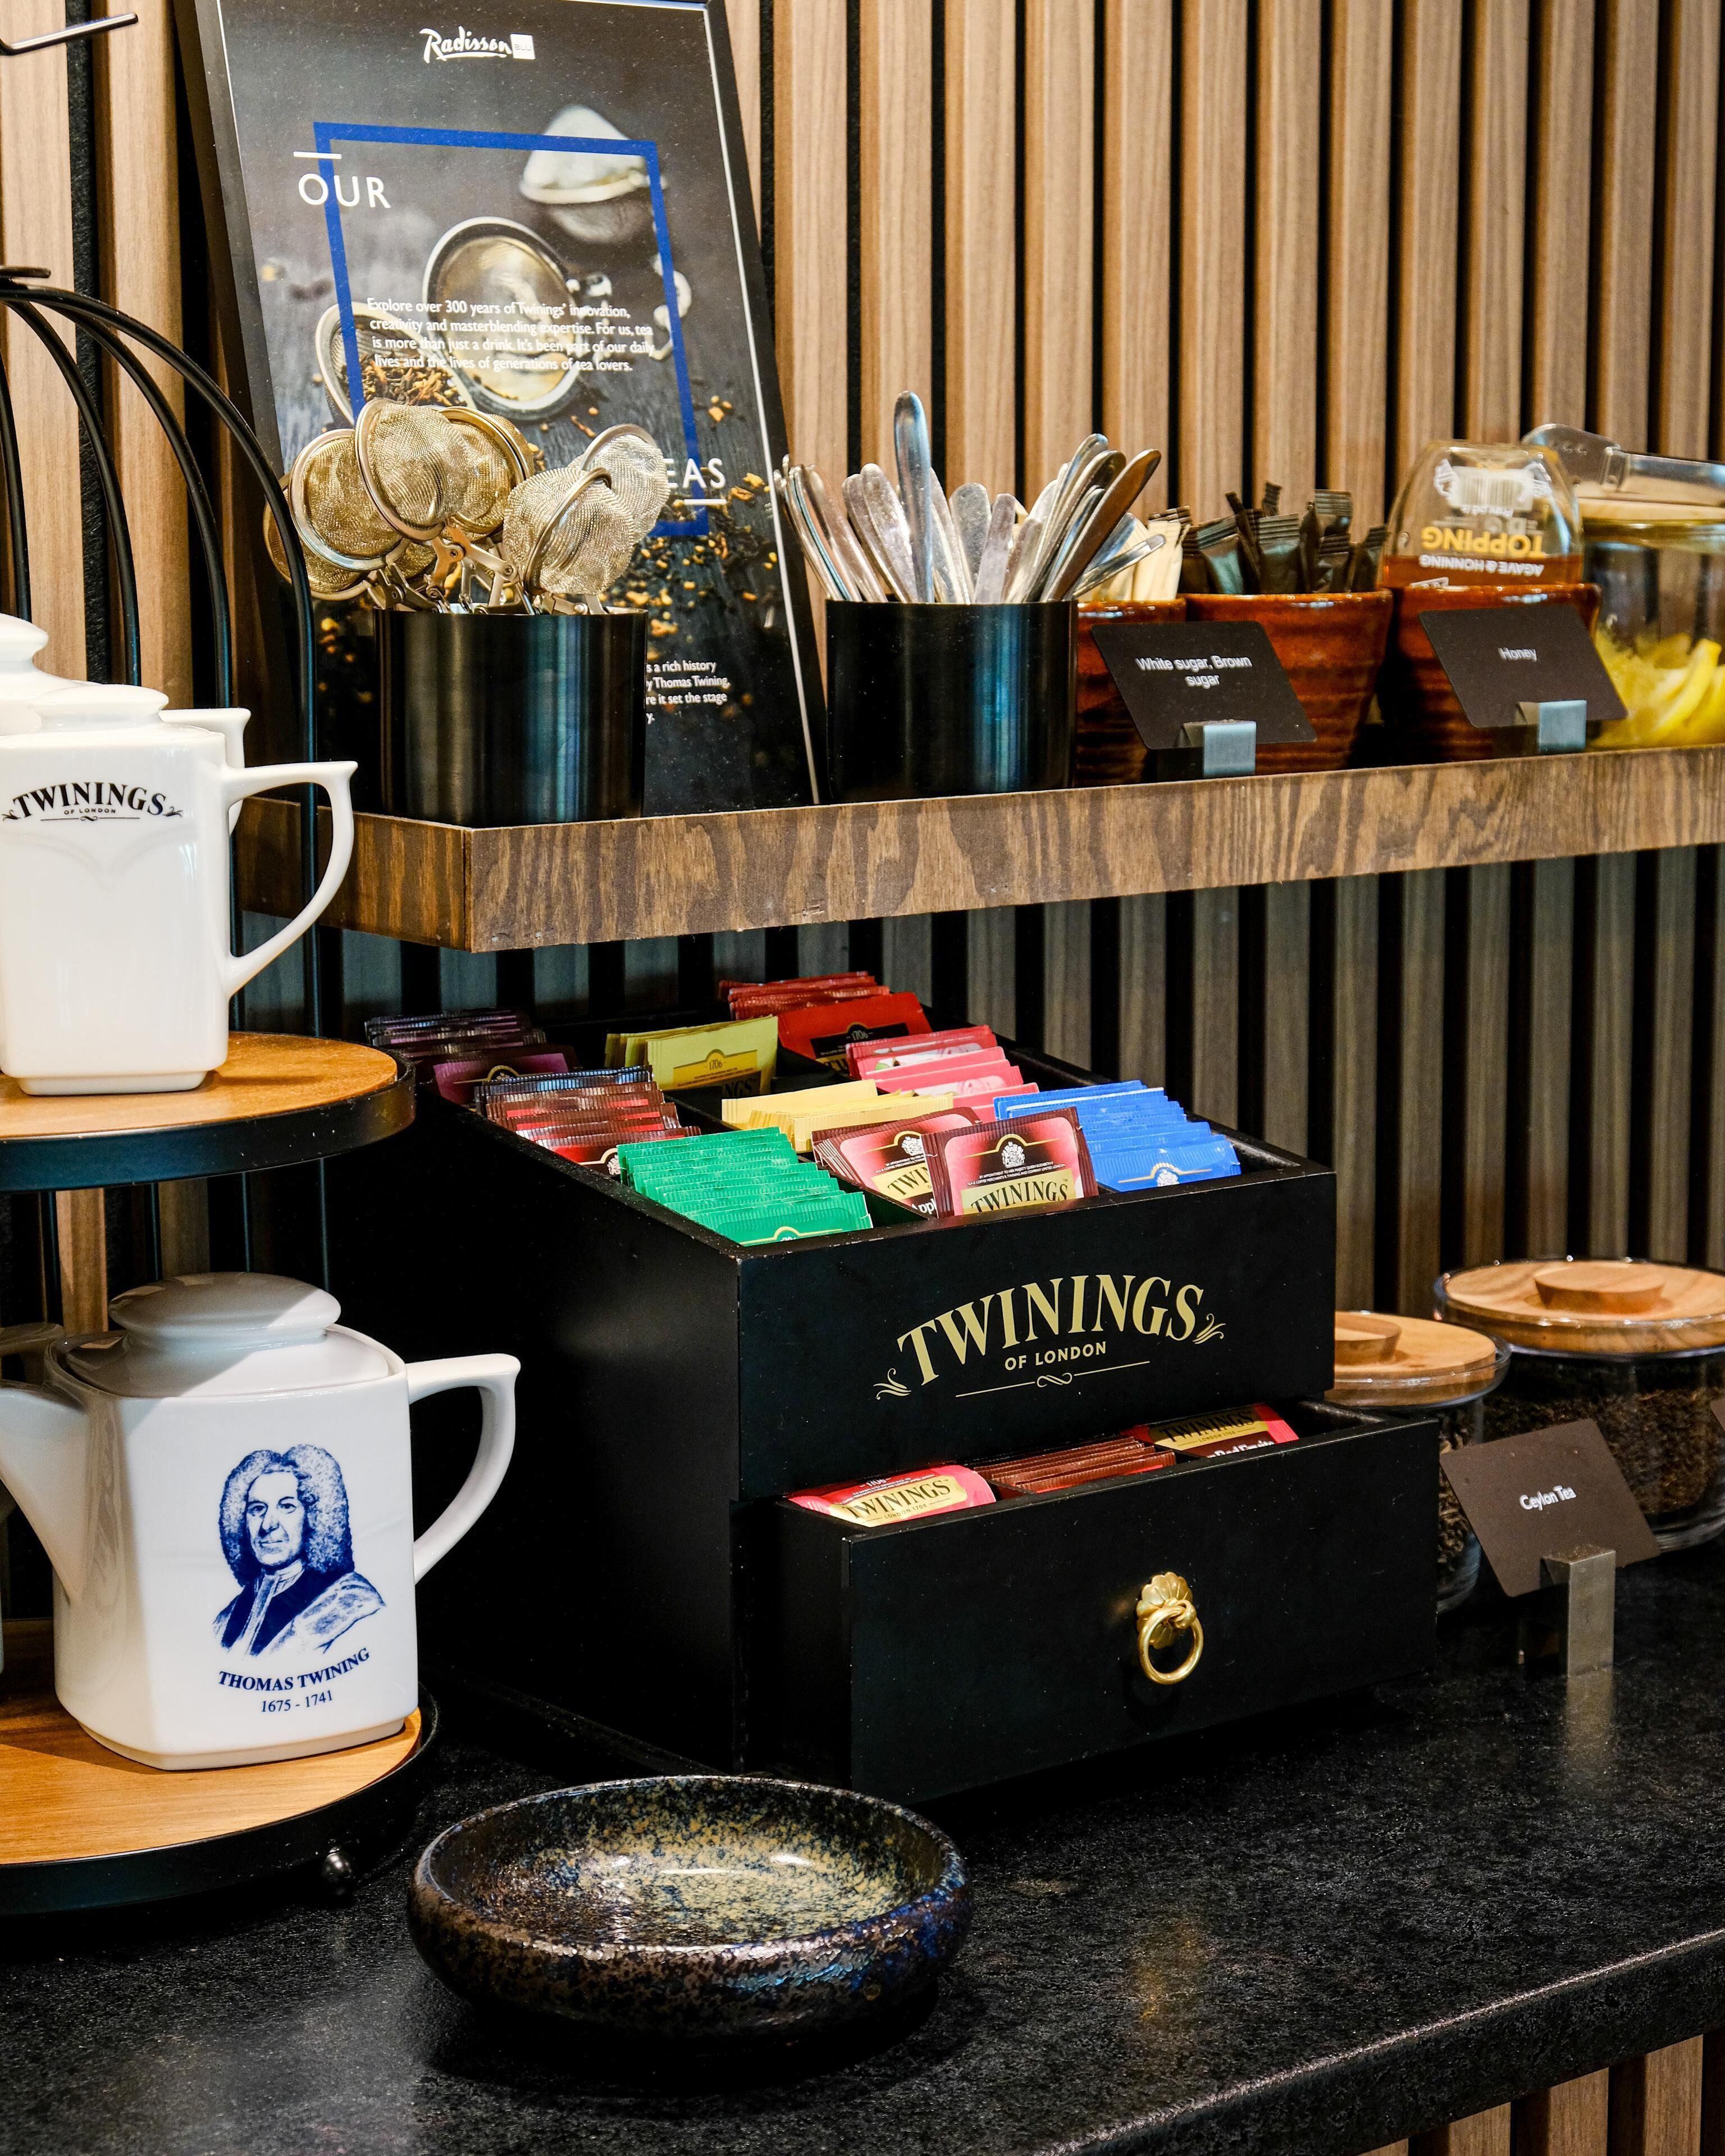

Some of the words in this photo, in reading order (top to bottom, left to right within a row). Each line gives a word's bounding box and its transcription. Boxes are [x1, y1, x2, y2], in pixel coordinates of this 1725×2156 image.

[419, 25, 512, 64] Radisson
[298, 173, 391, 208] OUR
[367, 298, 413, 315] Explore
[416, 303, 442, 313] over
[445, 300, 467, 313] 300
[469, 304, 501, 317] years
[504, 302, 515, 314] of
[569, 304, 631, 319] innovation,
[369, 318, 423, 334] creativity
[426, 319, 448, 331] and
[450, 319, 536, 336] masterblending
[541, 323, 595, 337] expertise.
[595, 322, 615, 335] For
[618, 326, 635, 336] us,
[635, 326, 653, 336] tea
[372, 336, 382, 348] is
[385, 339, 417, 349] more
[421, 337, 445, 350] than
[448, 338, 470, 353] just
[472, 341, 480, 350] a
[482, 338, 515, 351] drink.
[535, 339, 563, 351] been
[567, 342, 591, 356] part
[592, 340, 605, 353] of
[607, 342, 627, 353] our
[375, 354, 400, 367] lives
[403, 355, 425, 368] and
[427, 355, 447, 368] the
[450, 354, 475, 368] lives
[478, 356, 490, 368] of
[493, 357, 558, 372] generations
[561, 358, 574, 370] of
[577, 360, 594, 371] tea
[596, 358, 633, 371] lovers.
[663, 458, 725, 489] EAS
[1421, 526, 1545, 559] TOPPING
[1419, 554, 1485, 572] HONNING
[1485, 559, 1498, 573] &
[1498, 561, 1544, 577] AGAVE
[1135, 656, 1174, 670] White
[1211, 655, 1253, 669] Brown
[1498, 647, 1537, 662] Honey
[654, 664, 661, 673] a
[662, 660, 681, 672] rich
[682, 660, 717, 673] history
[652, 677, 692, 688] Thomas
[1185, 675, 1220, 689] sugar
[658, 693, 667, 705] it
[668, 695, 683, 704] set
[684, 692, 701, 704] the
[702, 693, 728, 706] stage
[13, 782, 166, 818] TWININGS
[851, 1030, 869, 1040] 1706
[709, 1059, 723, 1070] 1706
[971, 1181, 1067, 1213] TWININGS
[897, 1275, 1204, 1386] TWININGS
[1005, 1354, 1027, 1371] OF
[1035, 1341, 1107, 1366] LONDON
[1160, 1408, 1256, 1442] TWININGS
[842, 1480, 951, 1519] TWININGS
[1519, 1491, 1559, 1511] Ceylon
[1553, 1485, 1577, 1501] Tea
[884, 1508, 912, 1519] LONDON
[218, 1671, 293, 1691] THOMAS
[298, 1647, 370, 1688] TWINING
[261, 1699, 291, 1712] 1675
[305, 1690, 333, 1708] 1741
